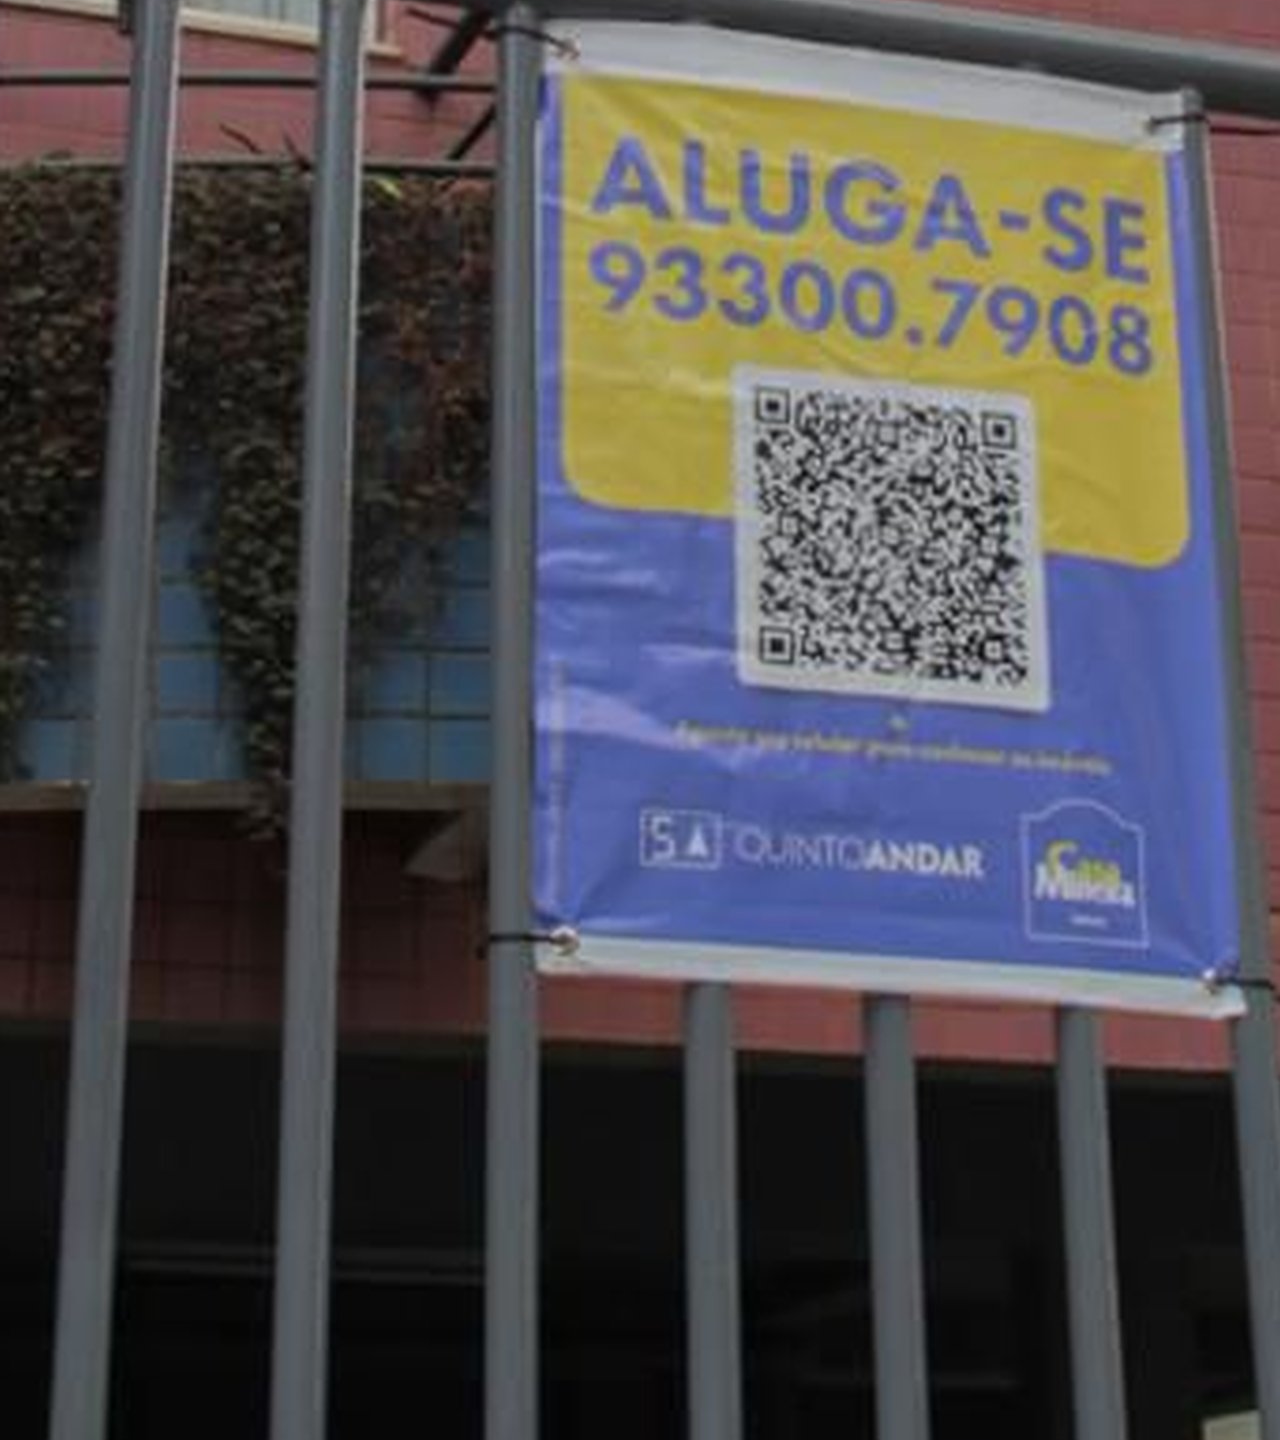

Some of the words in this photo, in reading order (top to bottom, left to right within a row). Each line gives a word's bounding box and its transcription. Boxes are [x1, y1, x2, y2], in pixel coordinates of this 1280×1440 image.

[590, 135, 1151, 285] ALUGA-SE
[587, 241, 1154, 377] 93300.7908
[734, 824, 984, 880] QUINTOANDAR
